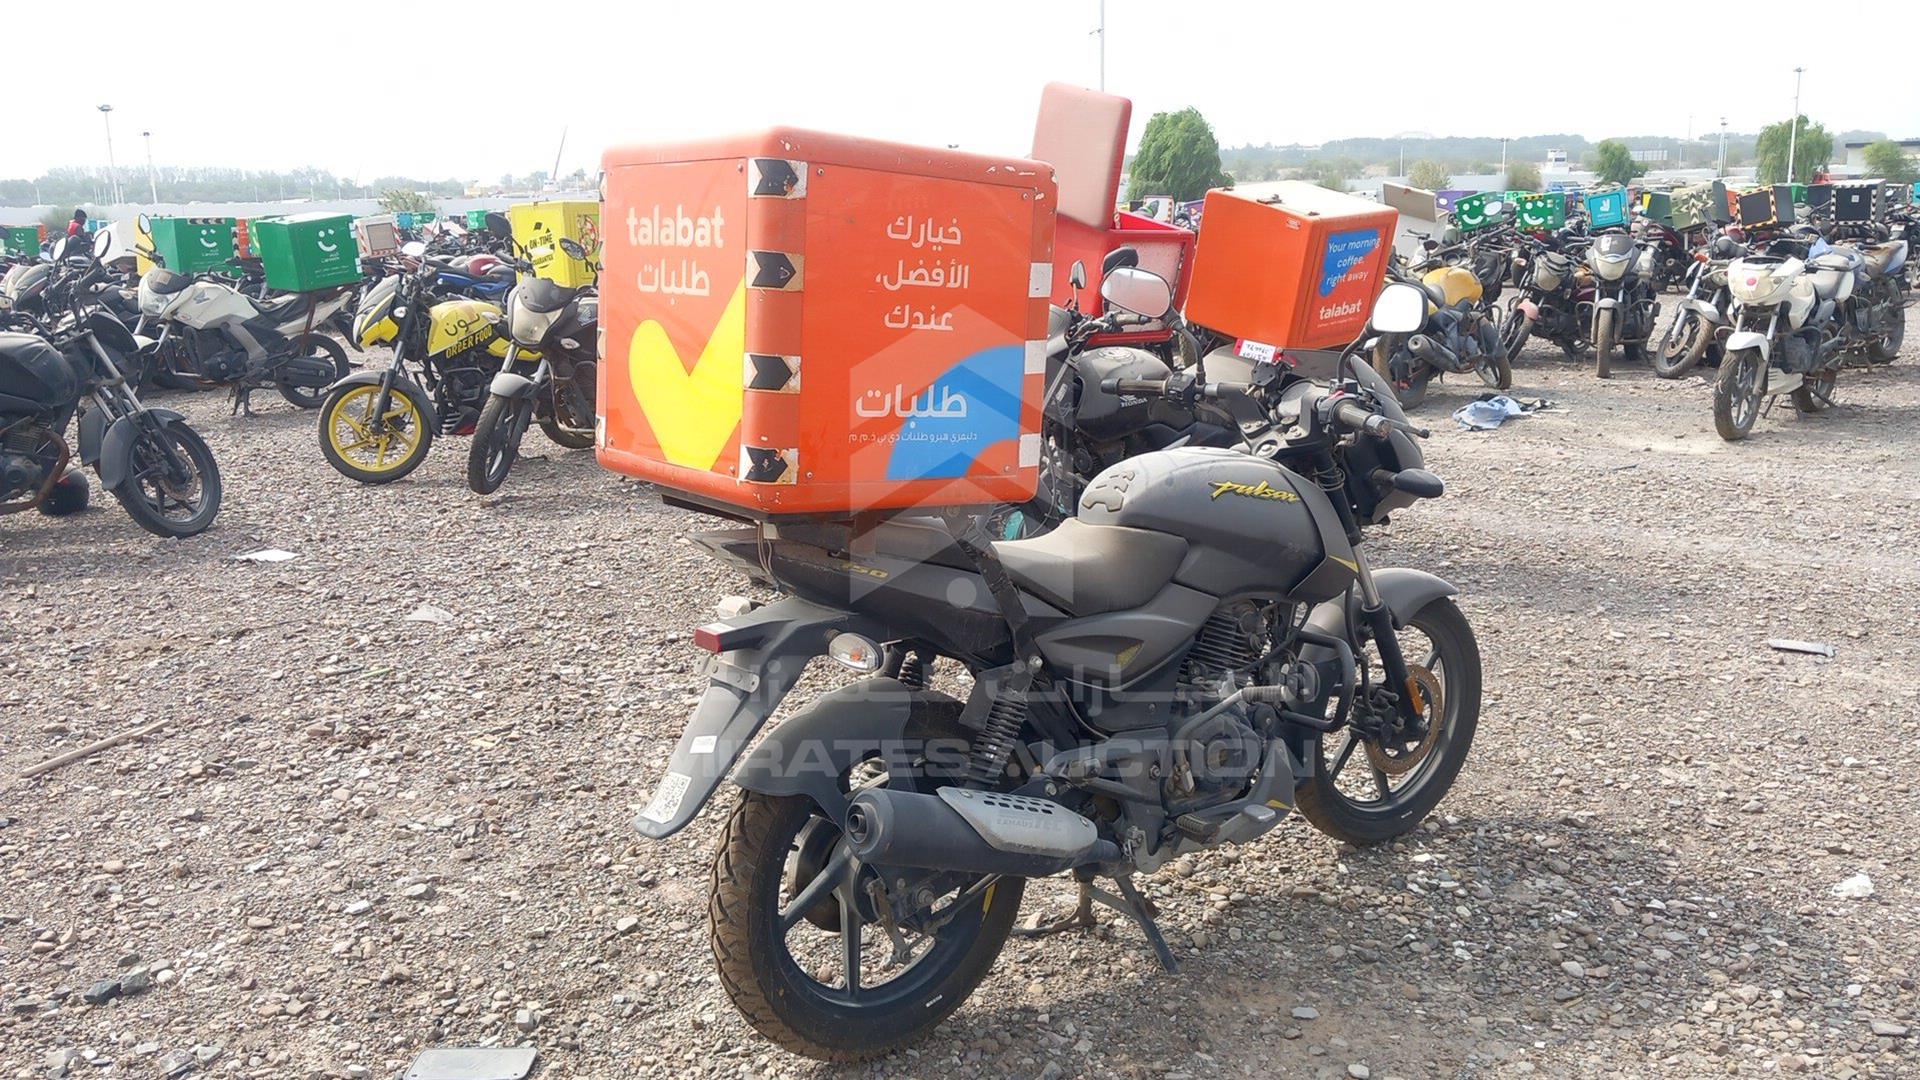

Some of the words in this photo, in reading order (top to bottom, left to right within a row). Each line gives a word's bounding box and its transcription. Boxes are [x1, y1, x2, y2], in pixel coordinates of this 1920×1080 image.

[625, 204, 725, 249] talabat
[887, 215, 962, 251] خيارك
[1328, 242, 1347, 253] Your
[1347, 238, 1381, 250] morning
[637, 259, 711, 305] طلبات
[1326, 274, 1346, 288] right
[1347, 271, 1368, 281] away
[884, 304, 954, 330] عندك
[1319, 299, 1362, 320] talabat
[445, 336, 475, 359] ORDER
[475, 324, 495, 345] FOOD
[855, 383, 968, 429] طلبات
